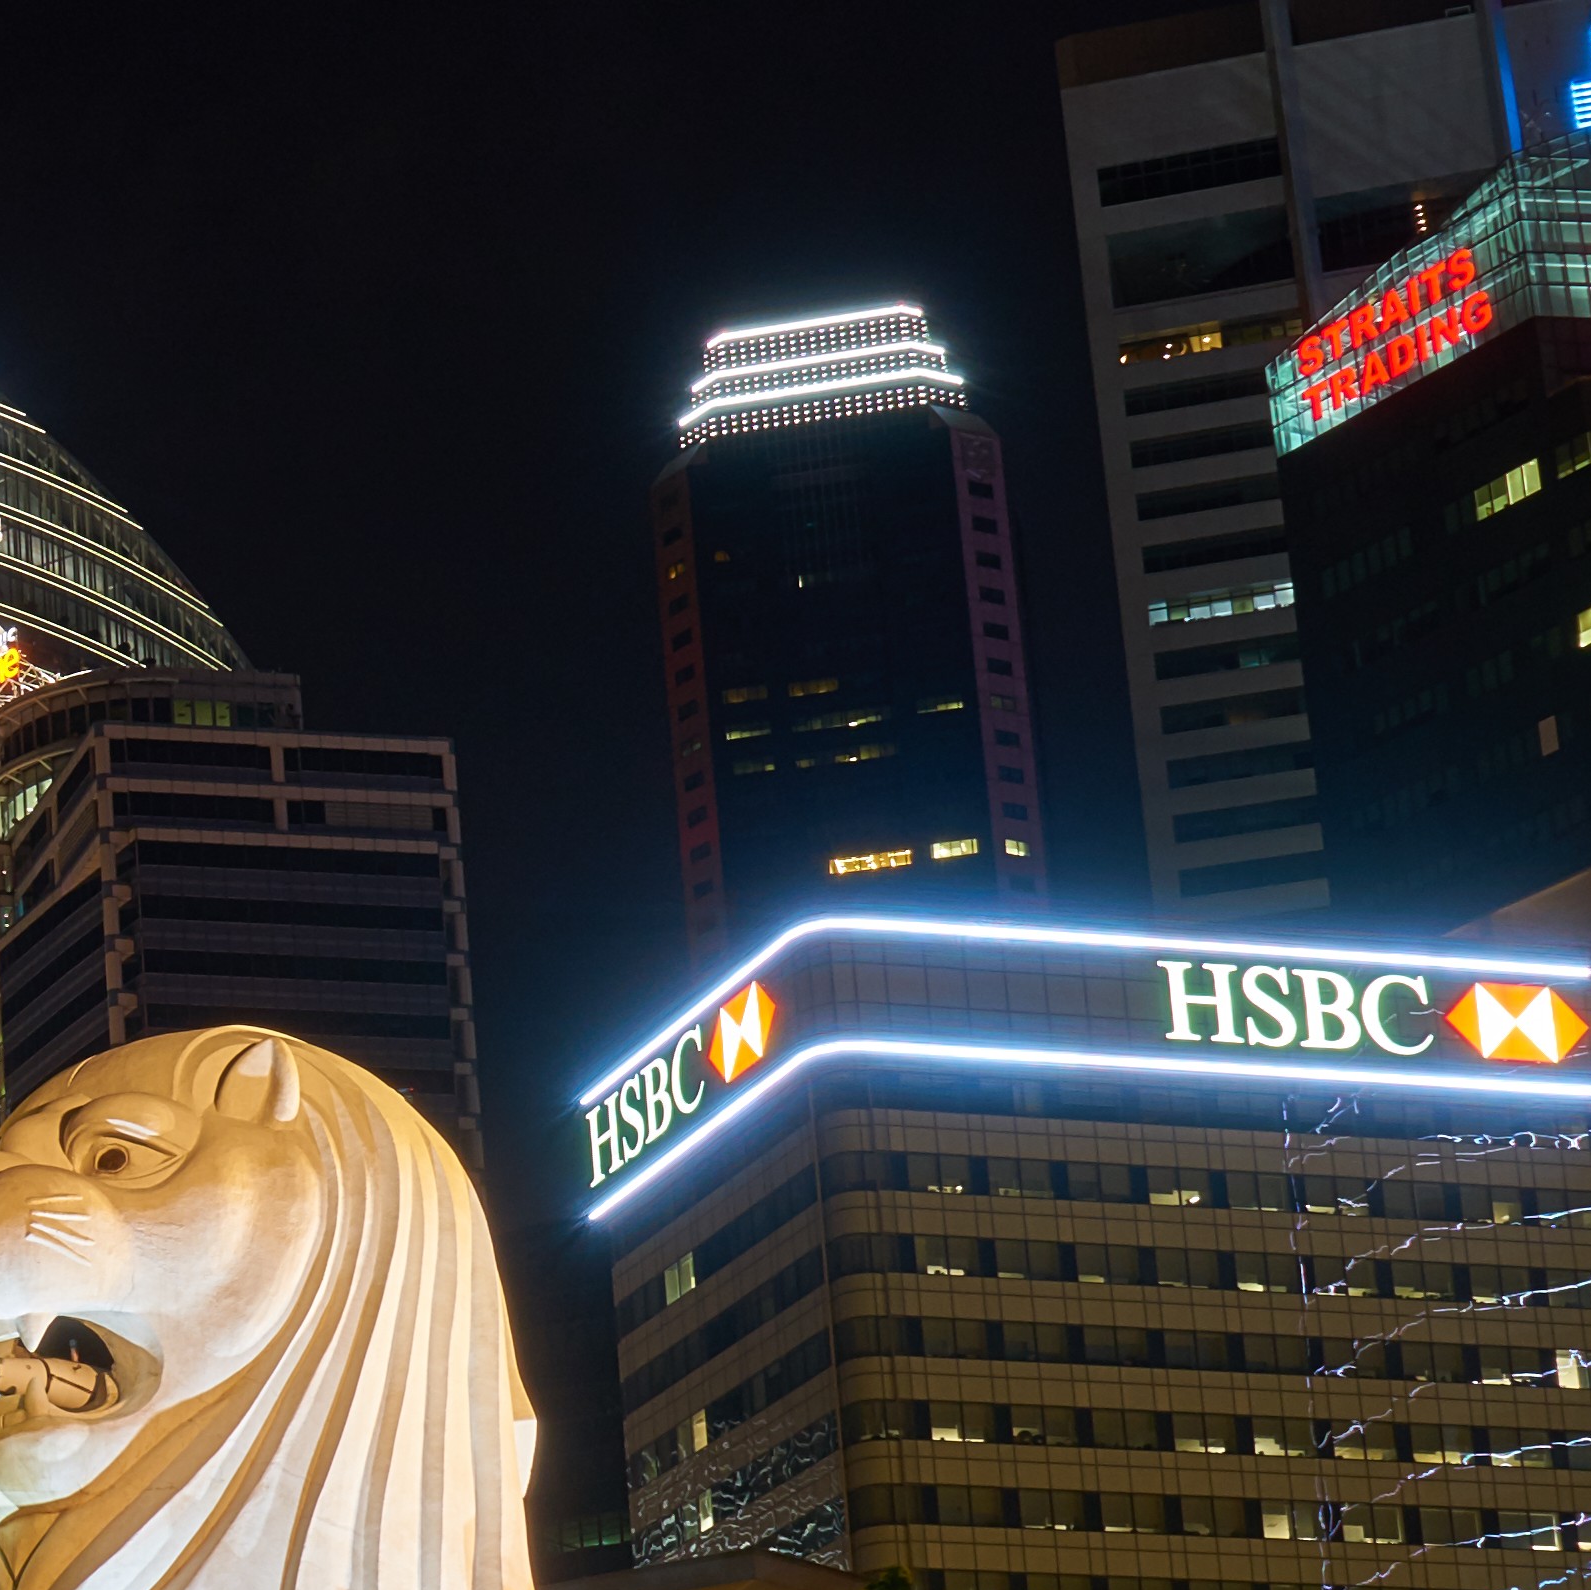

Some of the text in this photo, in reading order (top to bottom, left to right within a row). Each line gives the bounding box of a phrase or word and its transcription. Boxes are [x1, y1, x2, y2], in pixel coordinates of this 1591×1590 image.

[1298, 248, 1476, 378] STRAITS
[1302, 291, 1493, 423] TRADING
[1157, 959, 1435, 1056] HSBC
[585, 1024, 706, 1189] HSBC
